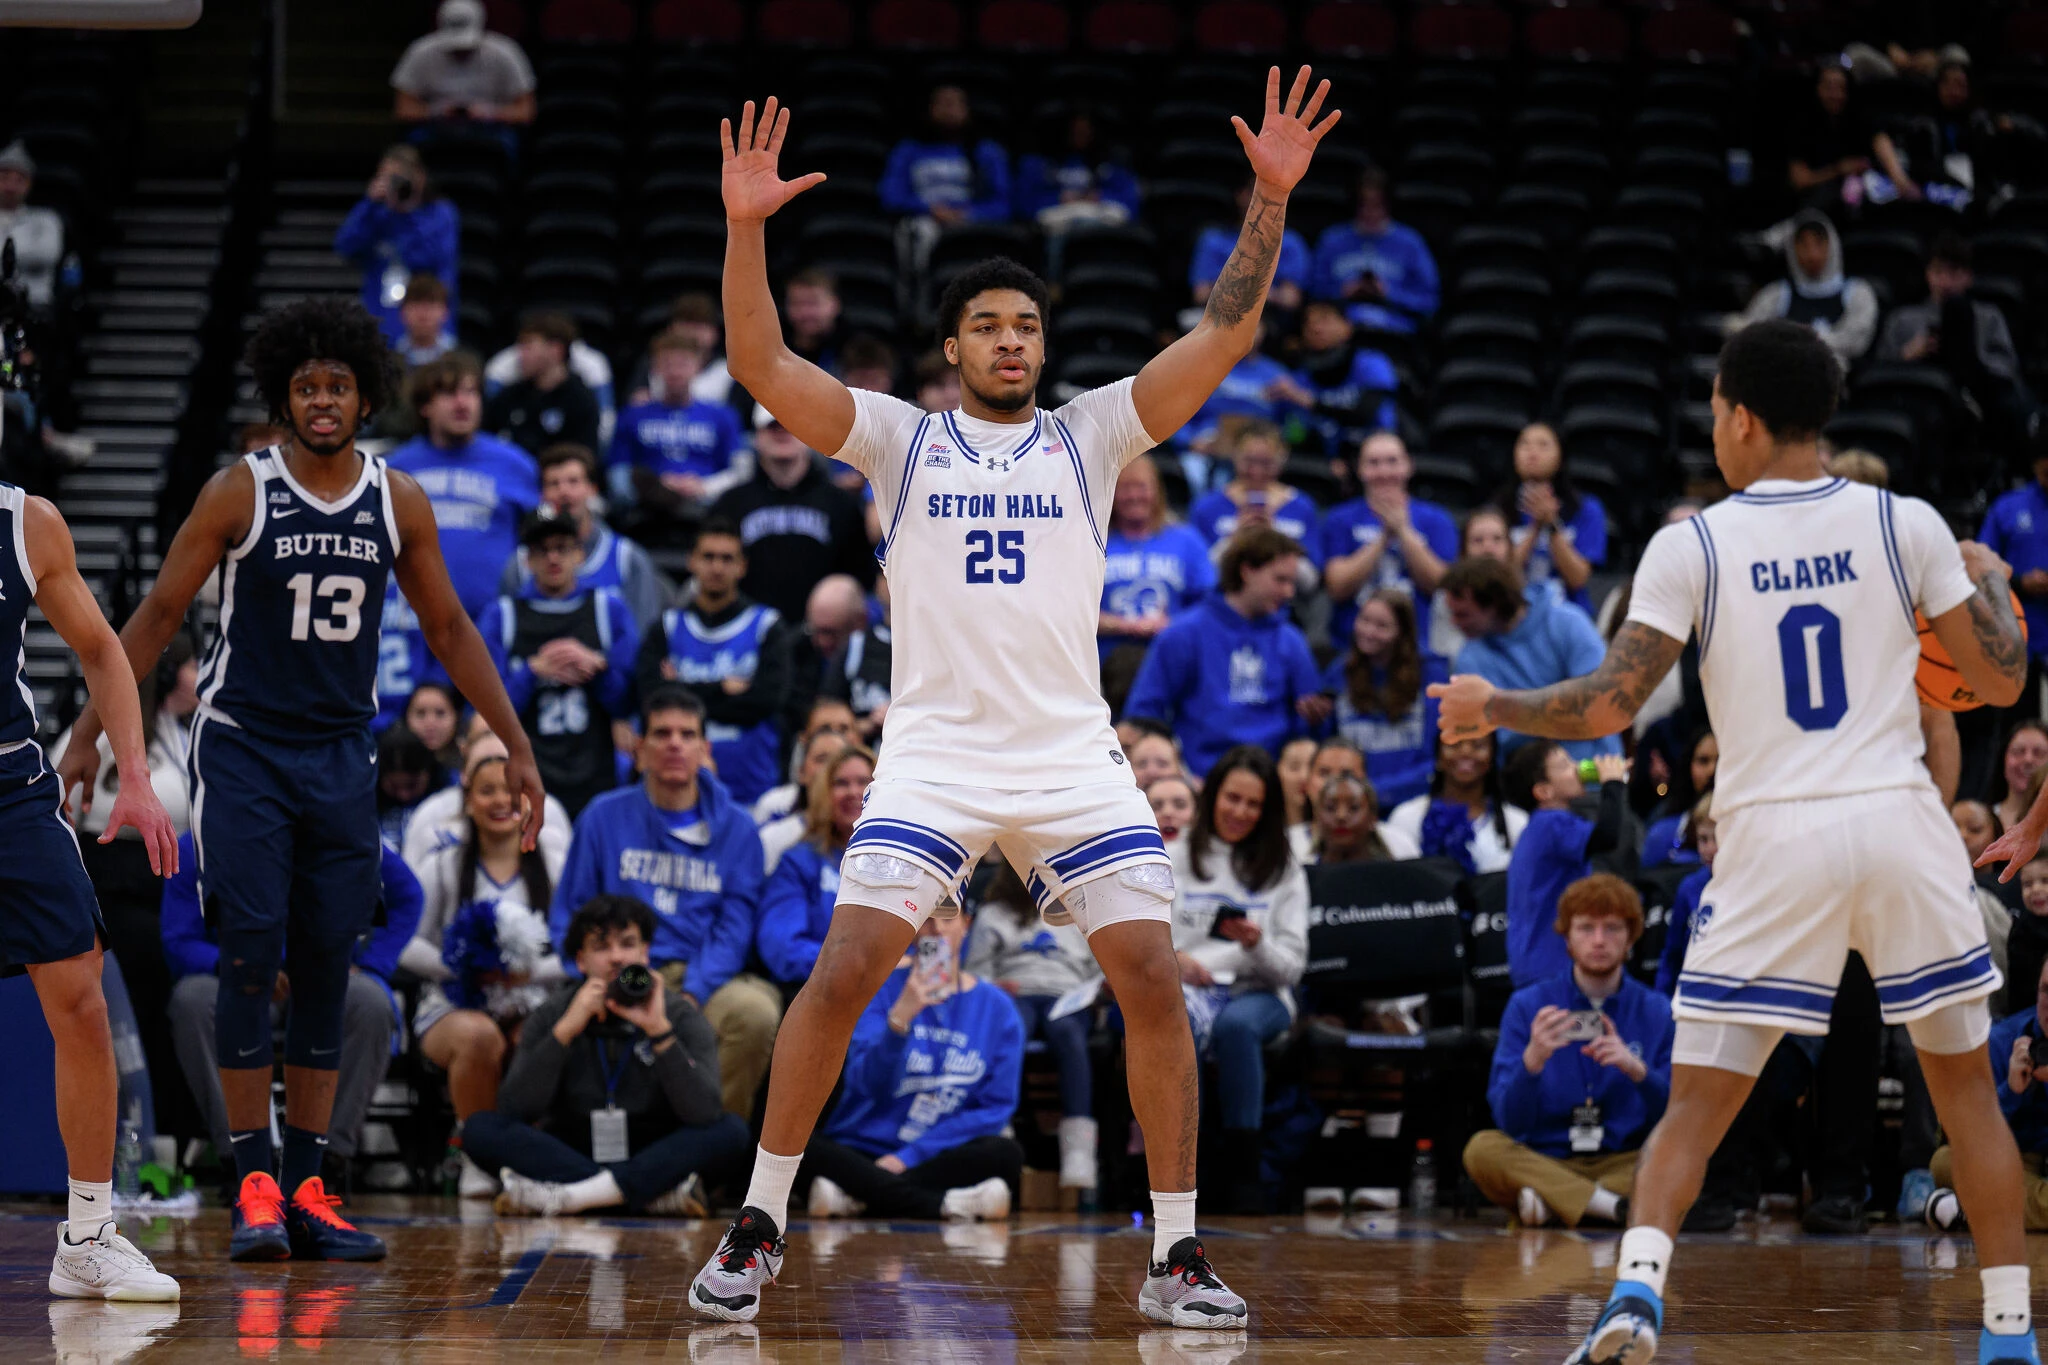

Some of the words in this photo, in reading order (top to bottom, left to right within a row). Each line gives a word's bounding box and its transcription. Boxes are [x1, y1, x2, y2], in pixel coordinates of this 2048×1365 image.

[924, 460, 951, 468] CHANGE
[928, 493, 995, 519] SETON
[1005, 494, 1064, 519] HALL
[274, 533, 381, 564] BUTLER
[965, 530, 1026, 584] 25
[1751, 550, 1858, 593] CLARK
[286, 573, 366, 642] 13
[1777, 603, 1849, 732] 0
[1325, 903, 1412, 926] Columbia
[1413, 897, 1458, 918] Bank
